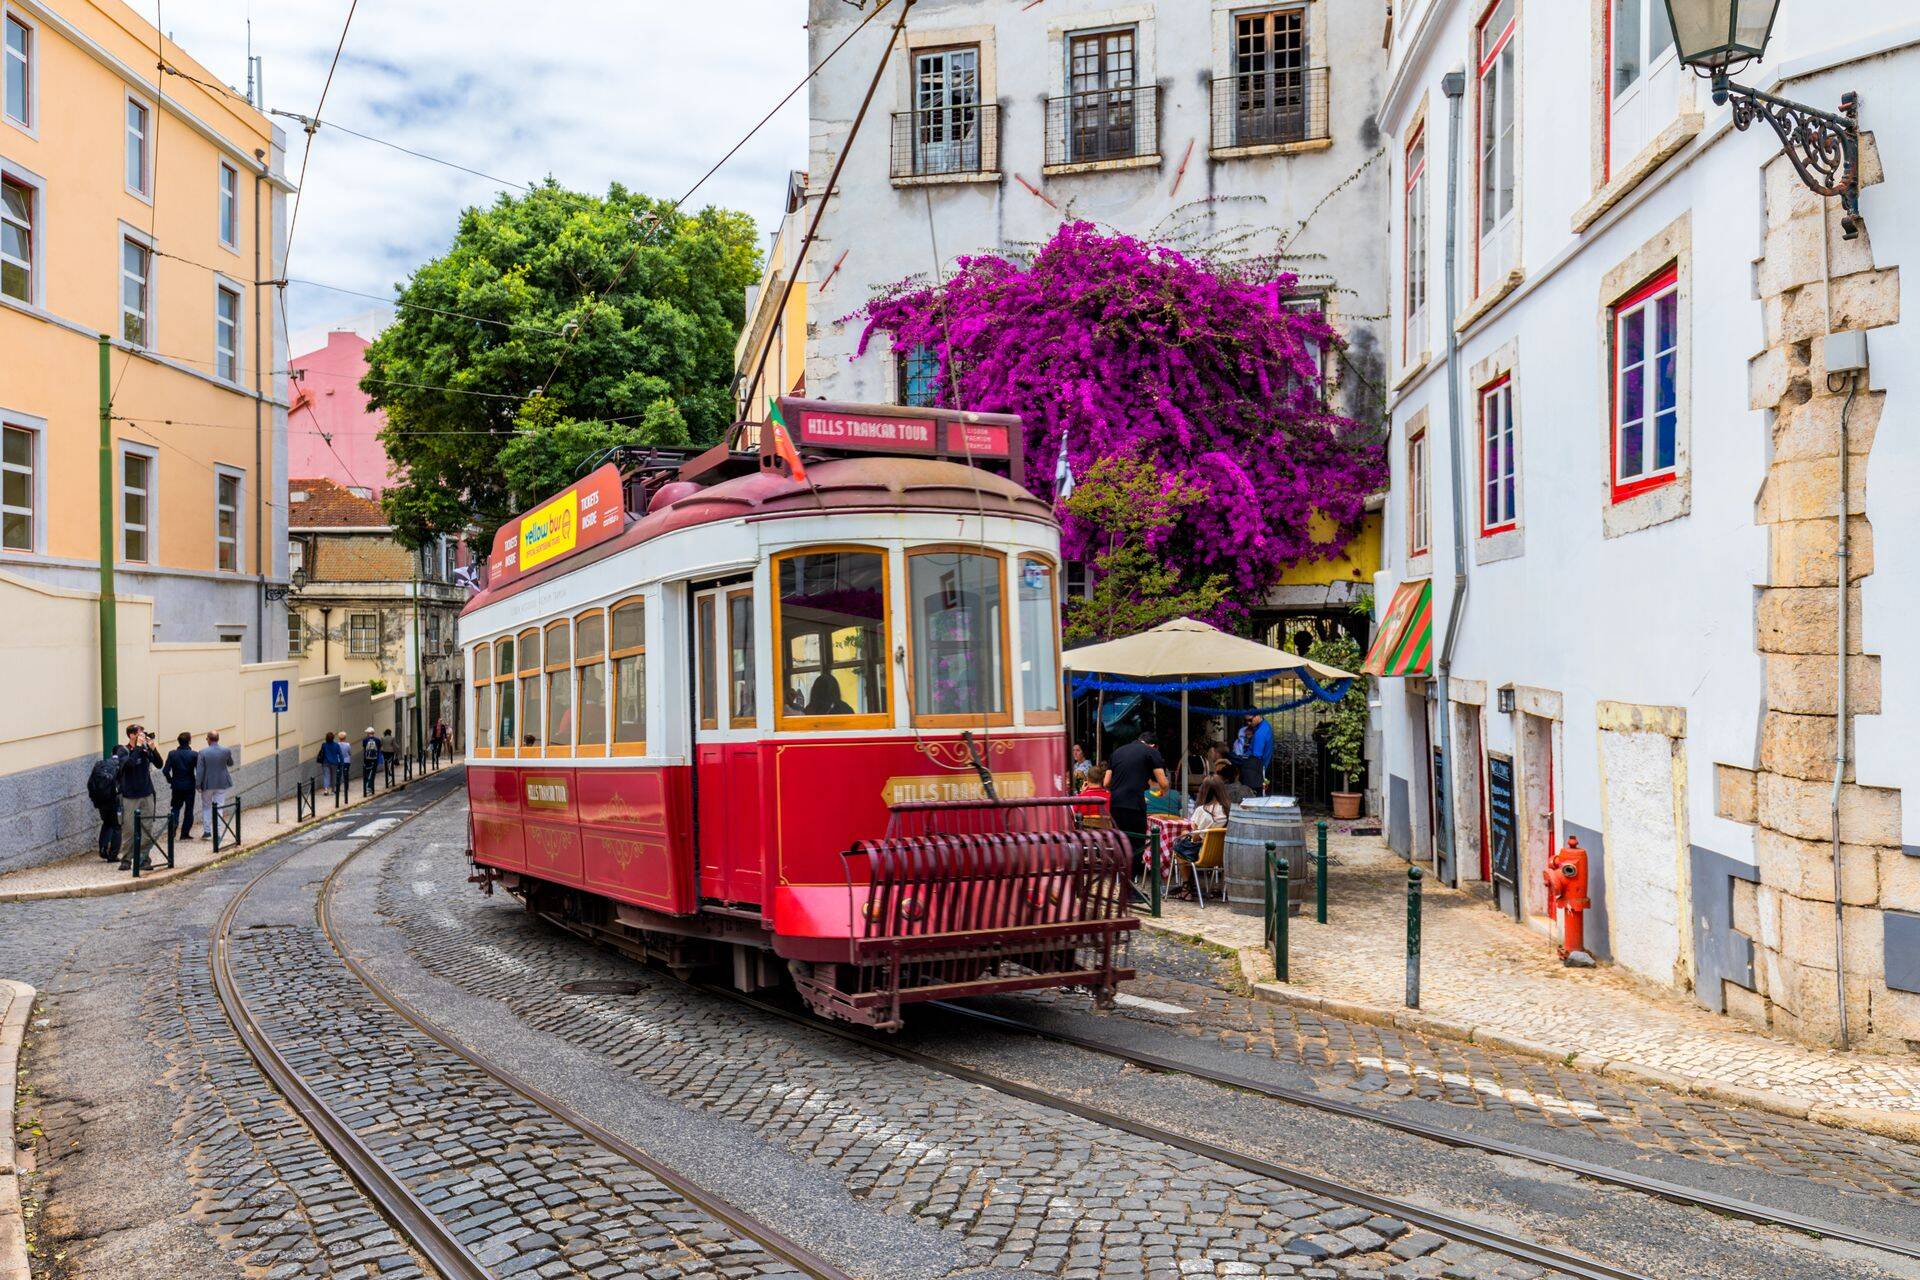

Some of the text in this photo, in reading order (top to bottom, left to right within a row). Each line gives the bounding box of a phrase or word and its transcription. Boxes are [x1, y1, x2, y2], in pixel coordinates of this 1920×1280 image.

[808, 418, 928, 441] HILLS TRAMCAR TOUR
[956, 518, 965, 537] 7
[893, 784, 939, 803] HILLS
[941, 781, 1001, 802] TRAMC
